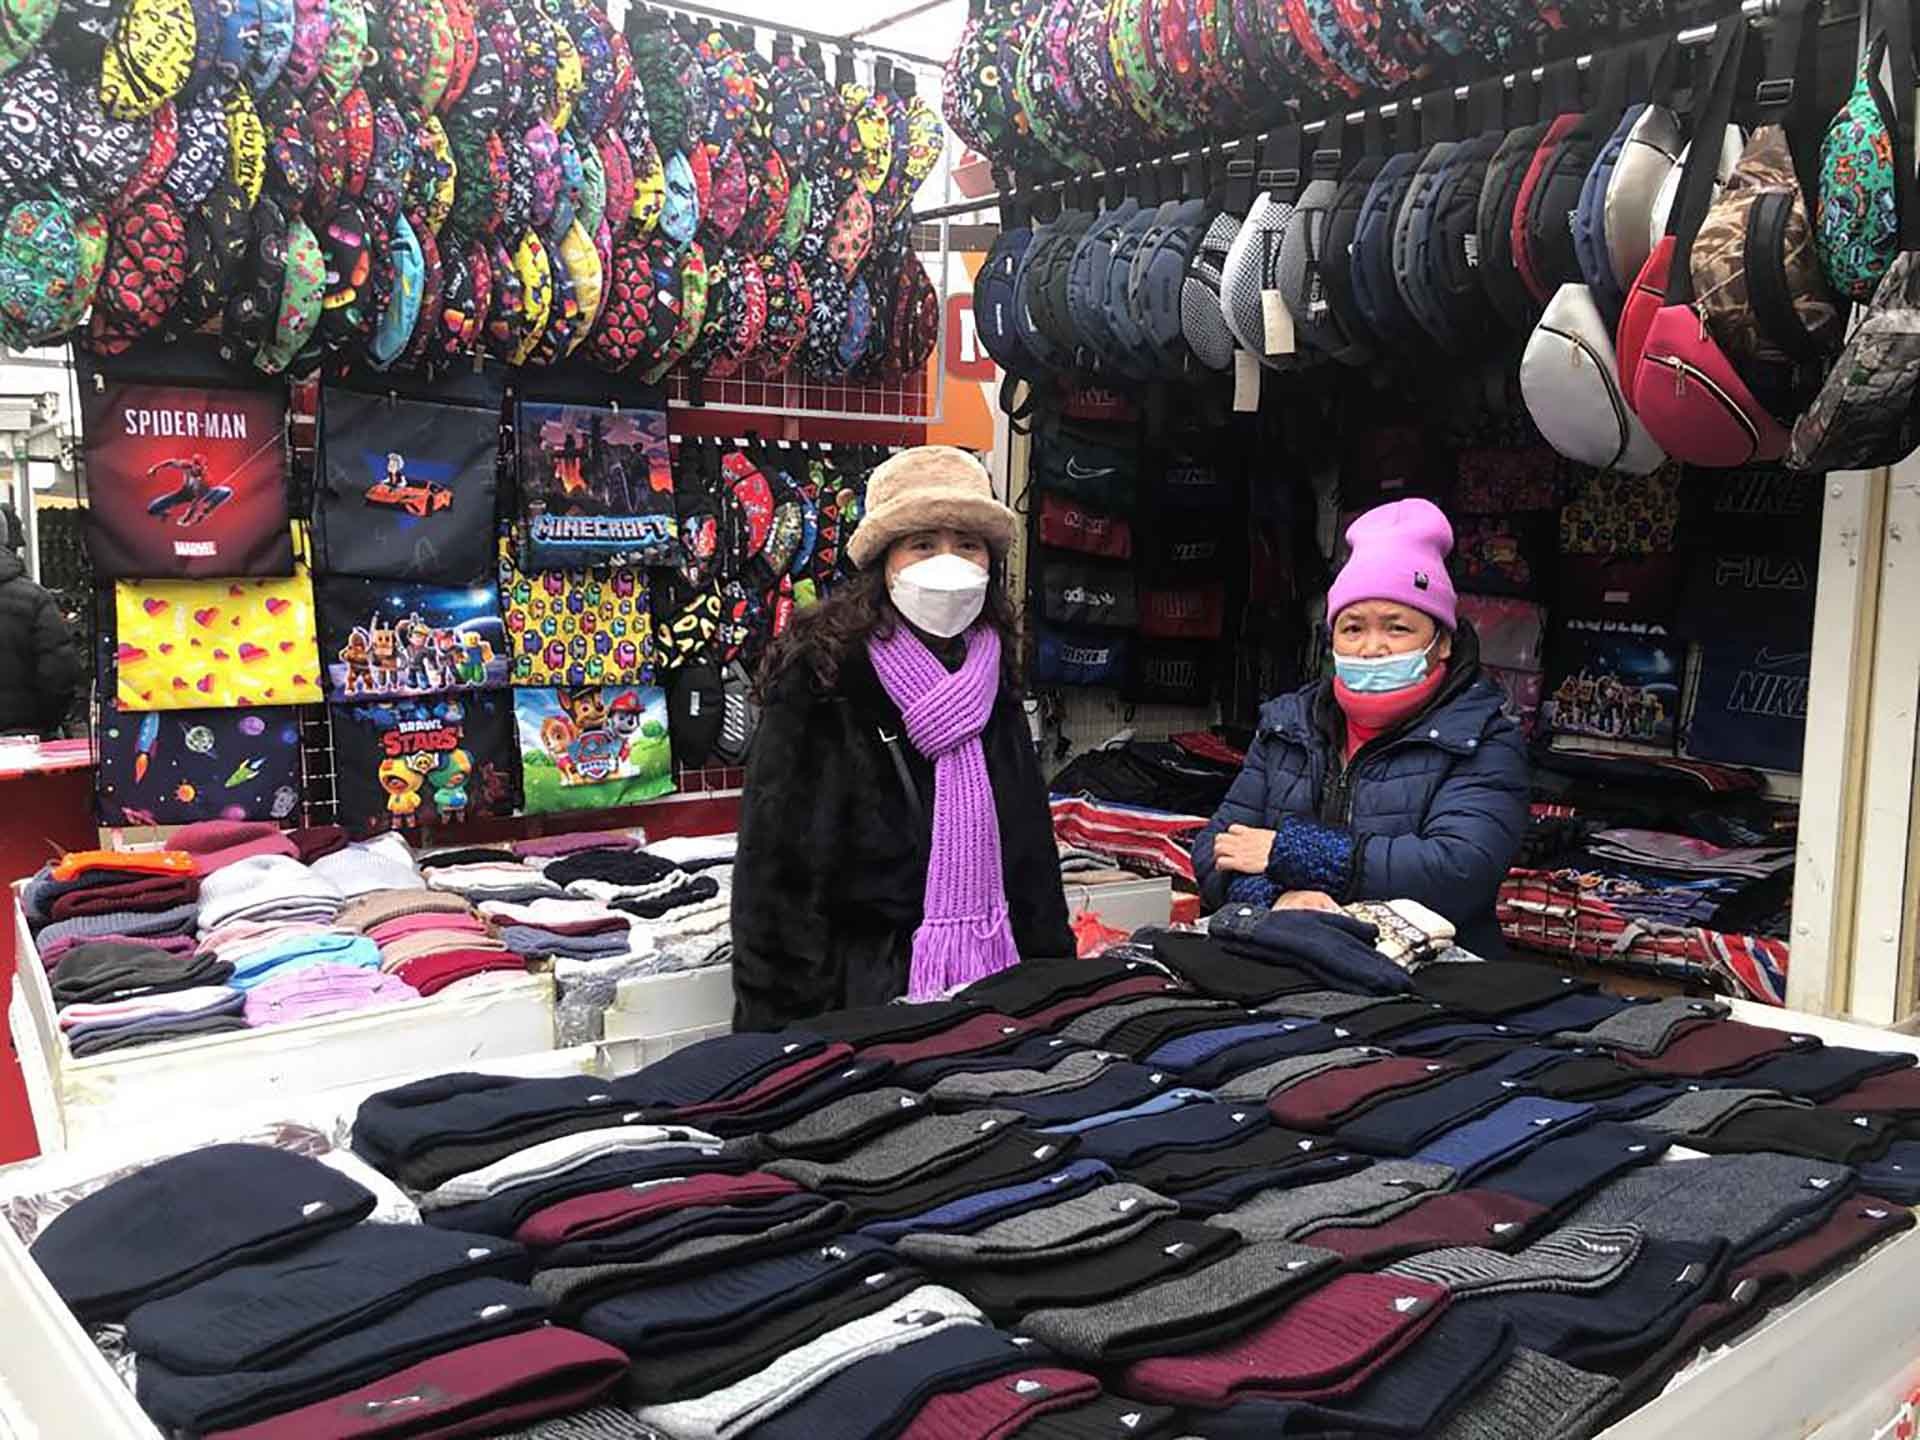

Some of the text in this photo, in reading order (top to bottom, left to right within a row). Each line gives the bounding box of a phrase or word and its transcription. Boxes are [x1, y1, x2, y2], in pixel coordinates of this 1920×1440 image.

[124, 409, 247, 439] SPIDER-MAN
[535, 516, 667, 543] MINECRAFT
[1715, 555, 1808, 590] FILA
[383, 727, 458, 757] STARS
